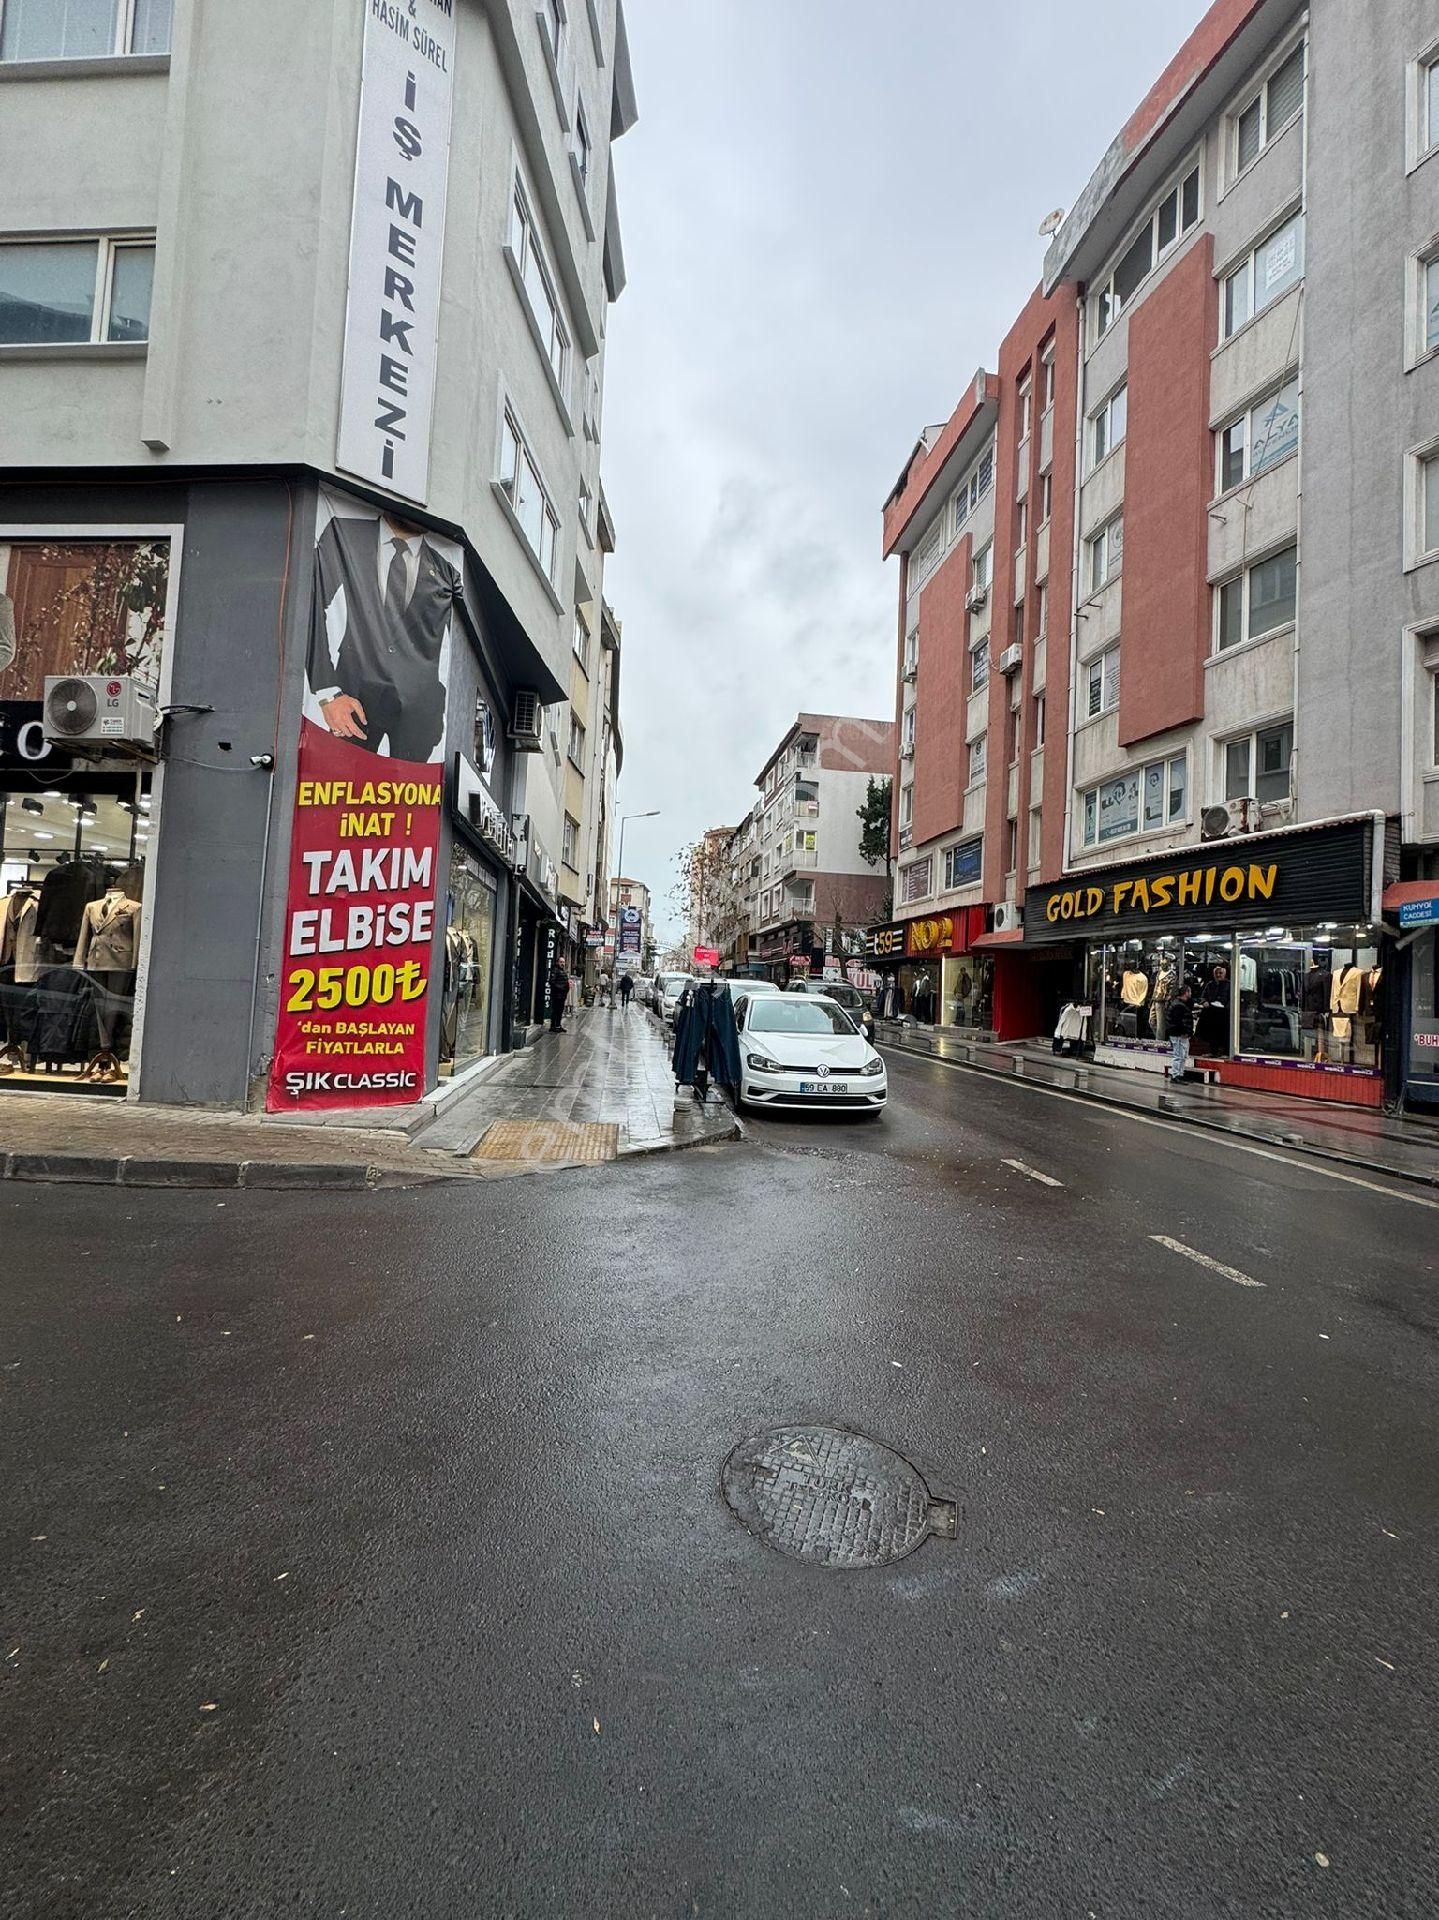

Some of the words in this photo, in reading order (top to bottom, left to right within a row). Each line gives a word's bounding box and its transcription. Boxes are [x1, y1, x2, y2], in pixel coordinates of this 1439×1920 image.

[412, 26, 448, 73] SÜREL
[374, 175, 424, 480] MERKEZİ
[107, 698, 120, 708] LG
[298, 781, 442, 807] ENFLASYONA
[302, 846, 433, 896] TAKIM
[1046, 886, 1105, 923] GOLD
[1112, 863, 1278, 915] FASHION
[289, 900, 435, 957] ELBİSE
[305, 1037, 405, 1056] FİYATLARLA
[335, 1021, 416, 1038] BAŞLAYAN
